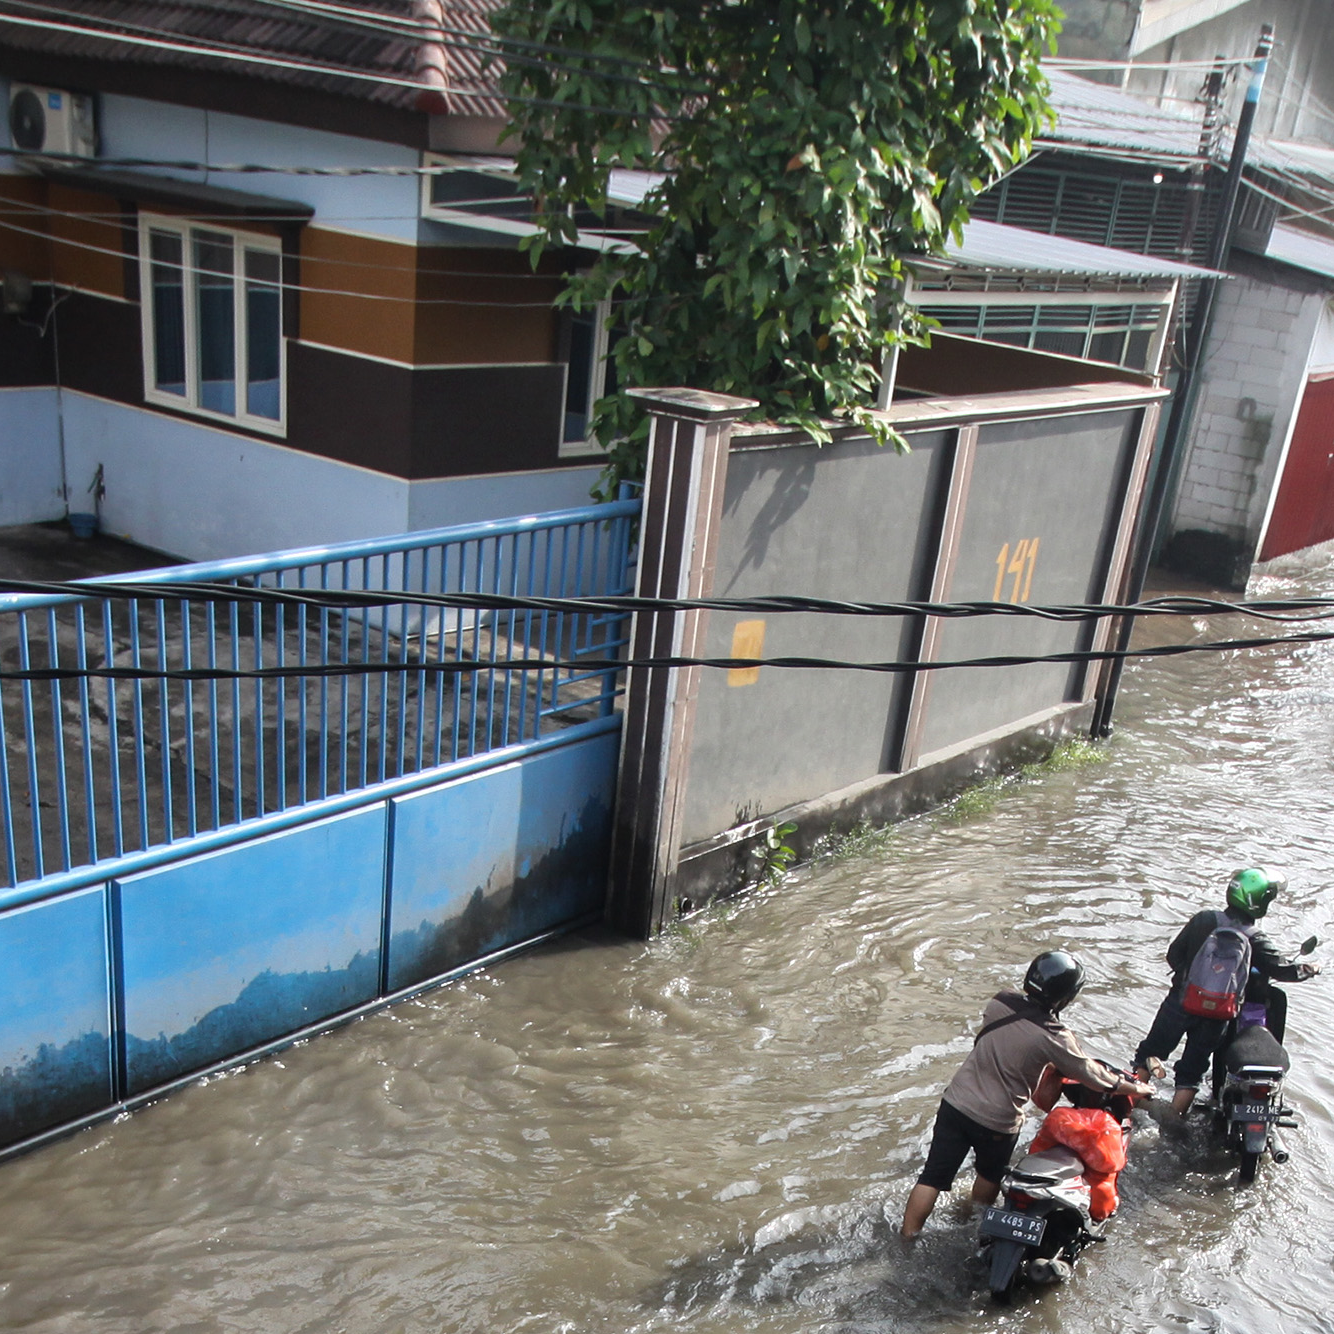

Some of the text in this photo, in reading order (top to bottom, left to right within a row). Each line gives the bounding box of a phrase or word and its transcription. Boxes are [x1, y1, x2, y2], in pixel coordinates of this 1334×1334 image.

[992, 537, 1040, 605] 141
[987, 1211, 1042, 1232] W 4485 PS
